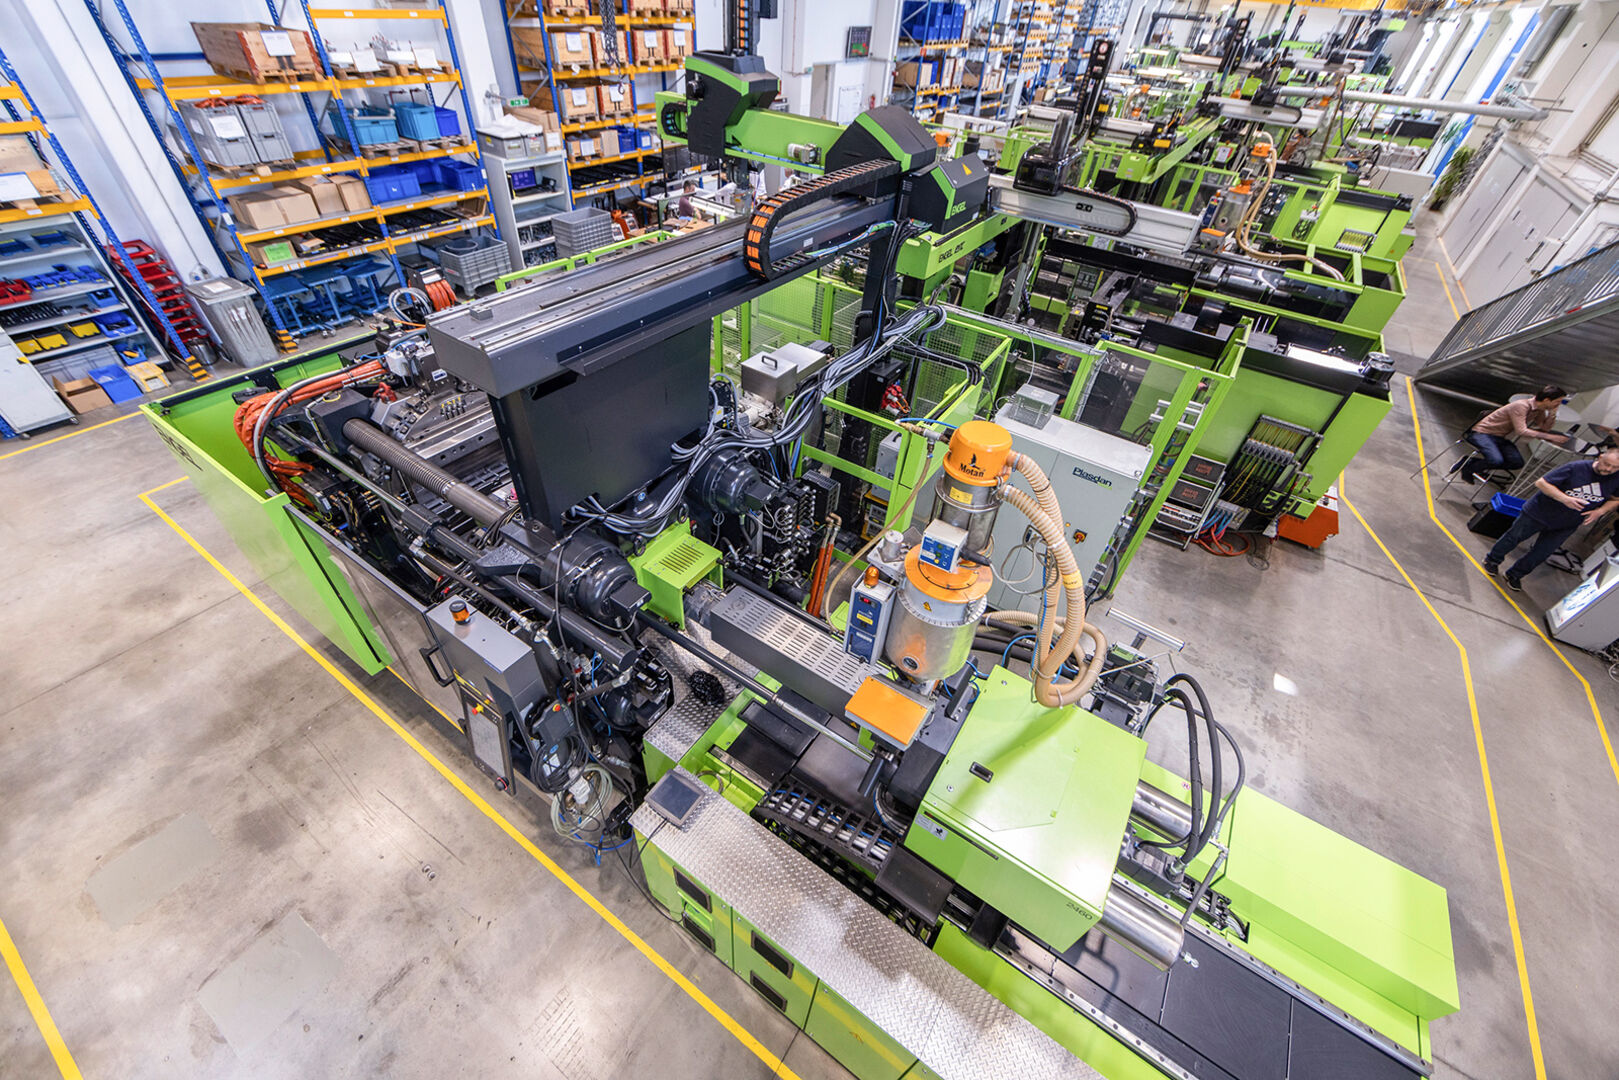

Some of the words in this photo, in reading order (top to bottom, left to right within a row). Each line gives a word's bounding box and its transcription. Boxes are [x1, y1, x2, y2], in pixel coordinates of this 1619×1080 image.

[951, 201, 966, 216] ENGEL
[959, 462, 985, 478] Motan
[1072, 466, 1112, 487] Plasdan
